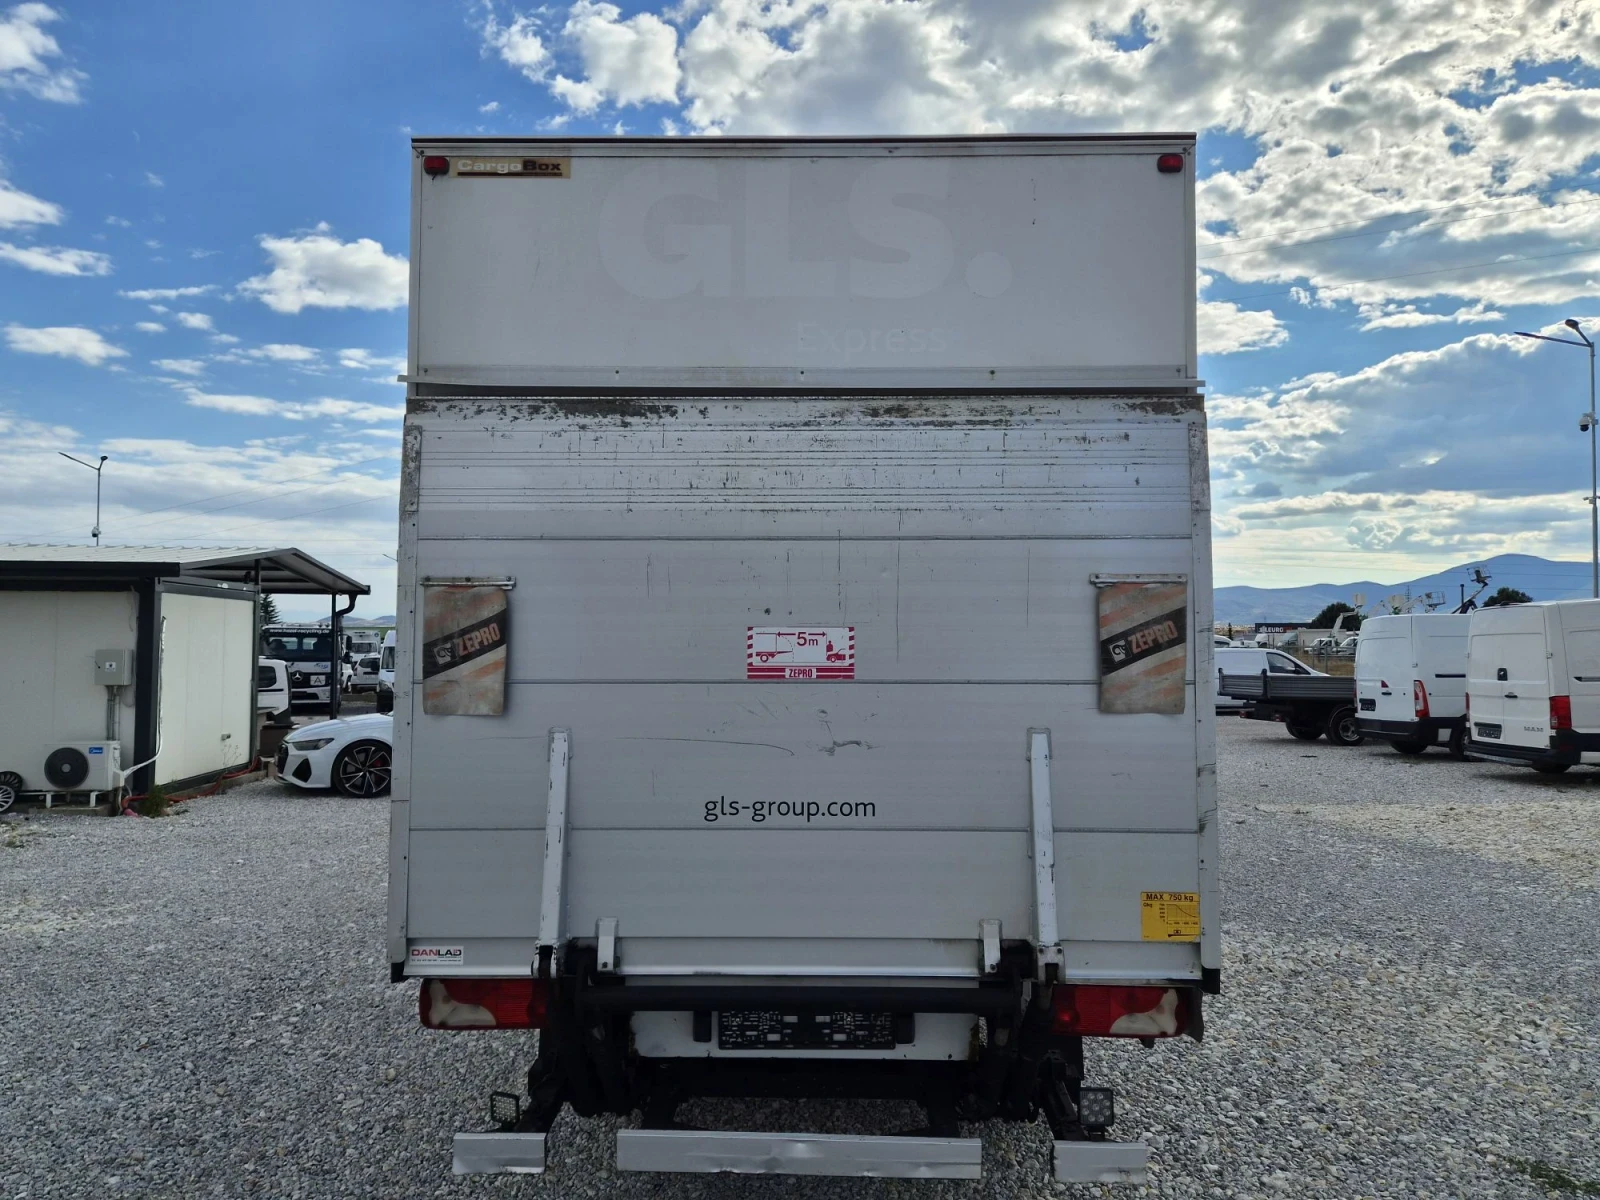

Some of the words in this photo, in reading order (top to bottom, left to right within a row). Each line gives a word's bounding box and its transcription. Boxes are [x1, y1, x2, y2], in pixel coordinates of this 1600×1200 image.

[457, 159, 561, 174] CargoBox
[796, 320, 948, 363] Express
[456, 622, 501, 656] ZEPRO
[1127, 620, 1179, 654] ZEPRO
[313, 676, 323, 684] A
[788, 668, 813, 678] ZEPRO
[704, 795, 876, 823] gls-group.com
[1183, 895, 1194, 903] kg
